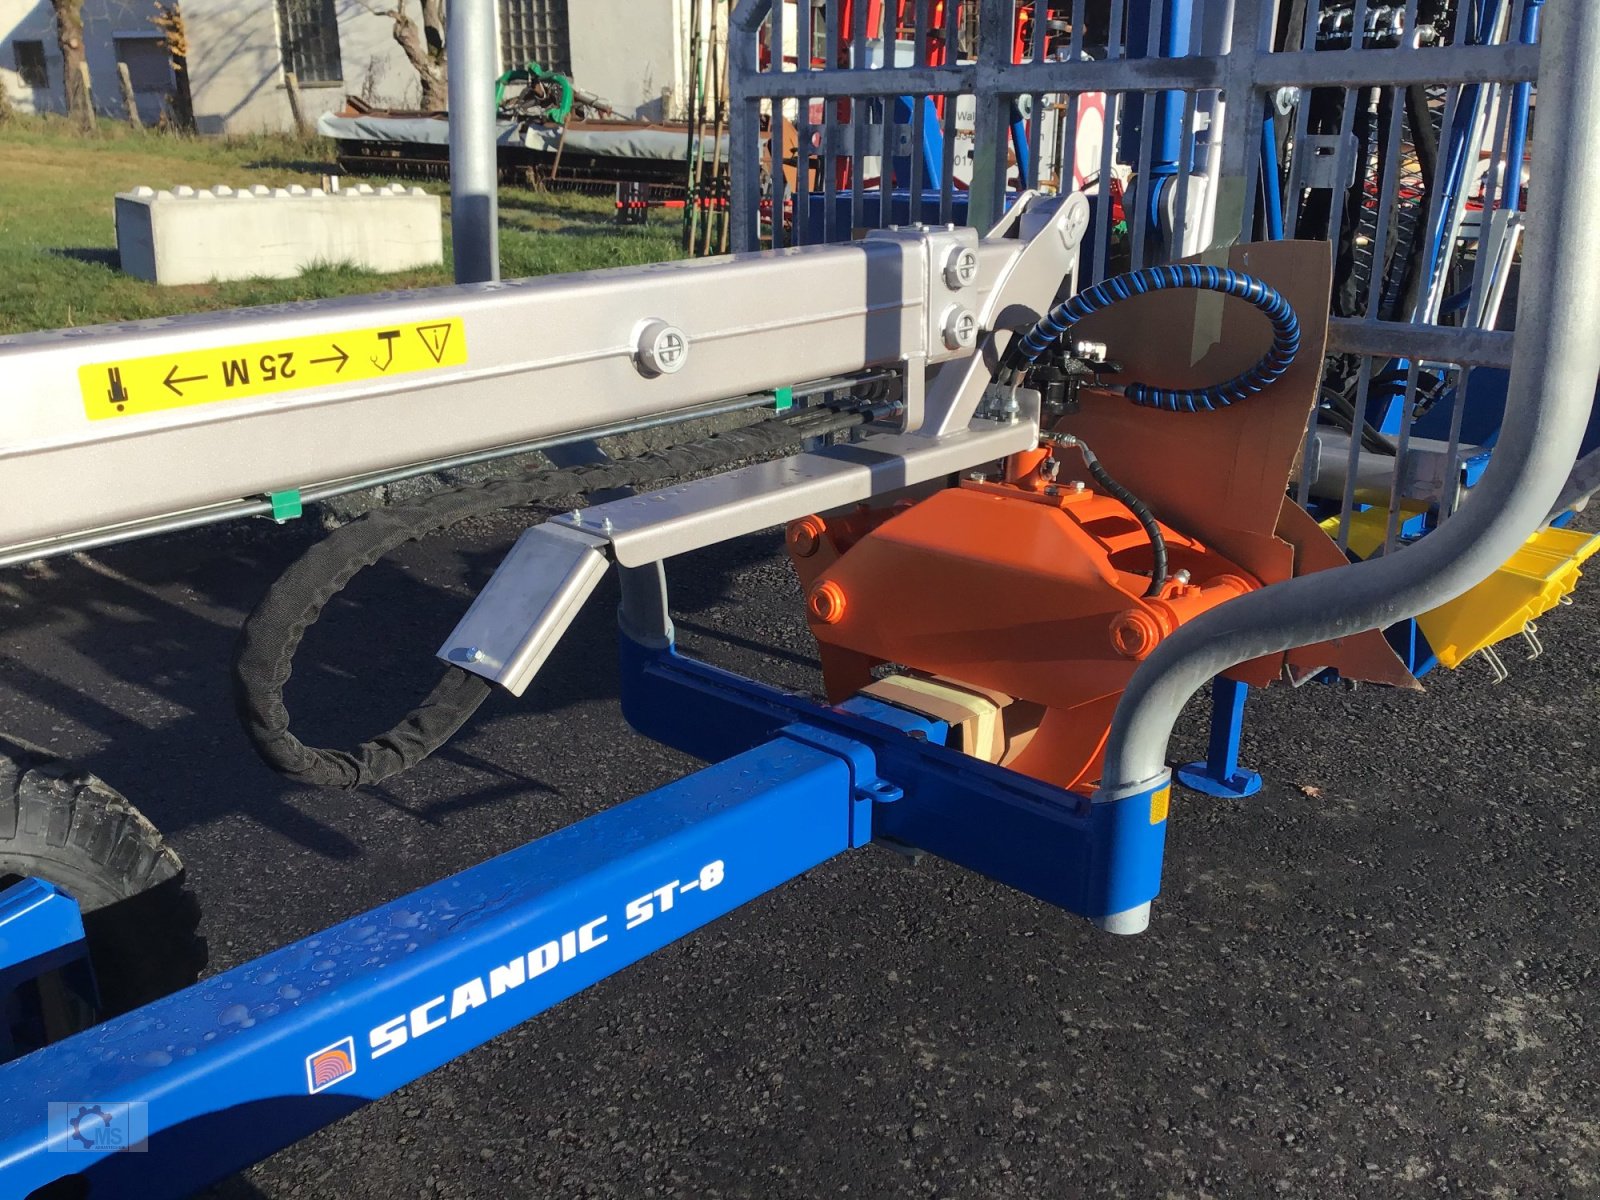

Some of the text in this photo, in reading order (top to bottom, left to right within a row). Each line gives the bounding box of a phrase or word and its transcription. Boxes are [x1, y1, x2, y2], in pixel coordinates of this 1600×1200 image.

[221, 352, 296, 387] 25 M
[369, 859, 726, 1059] SCANDIC ST-8
